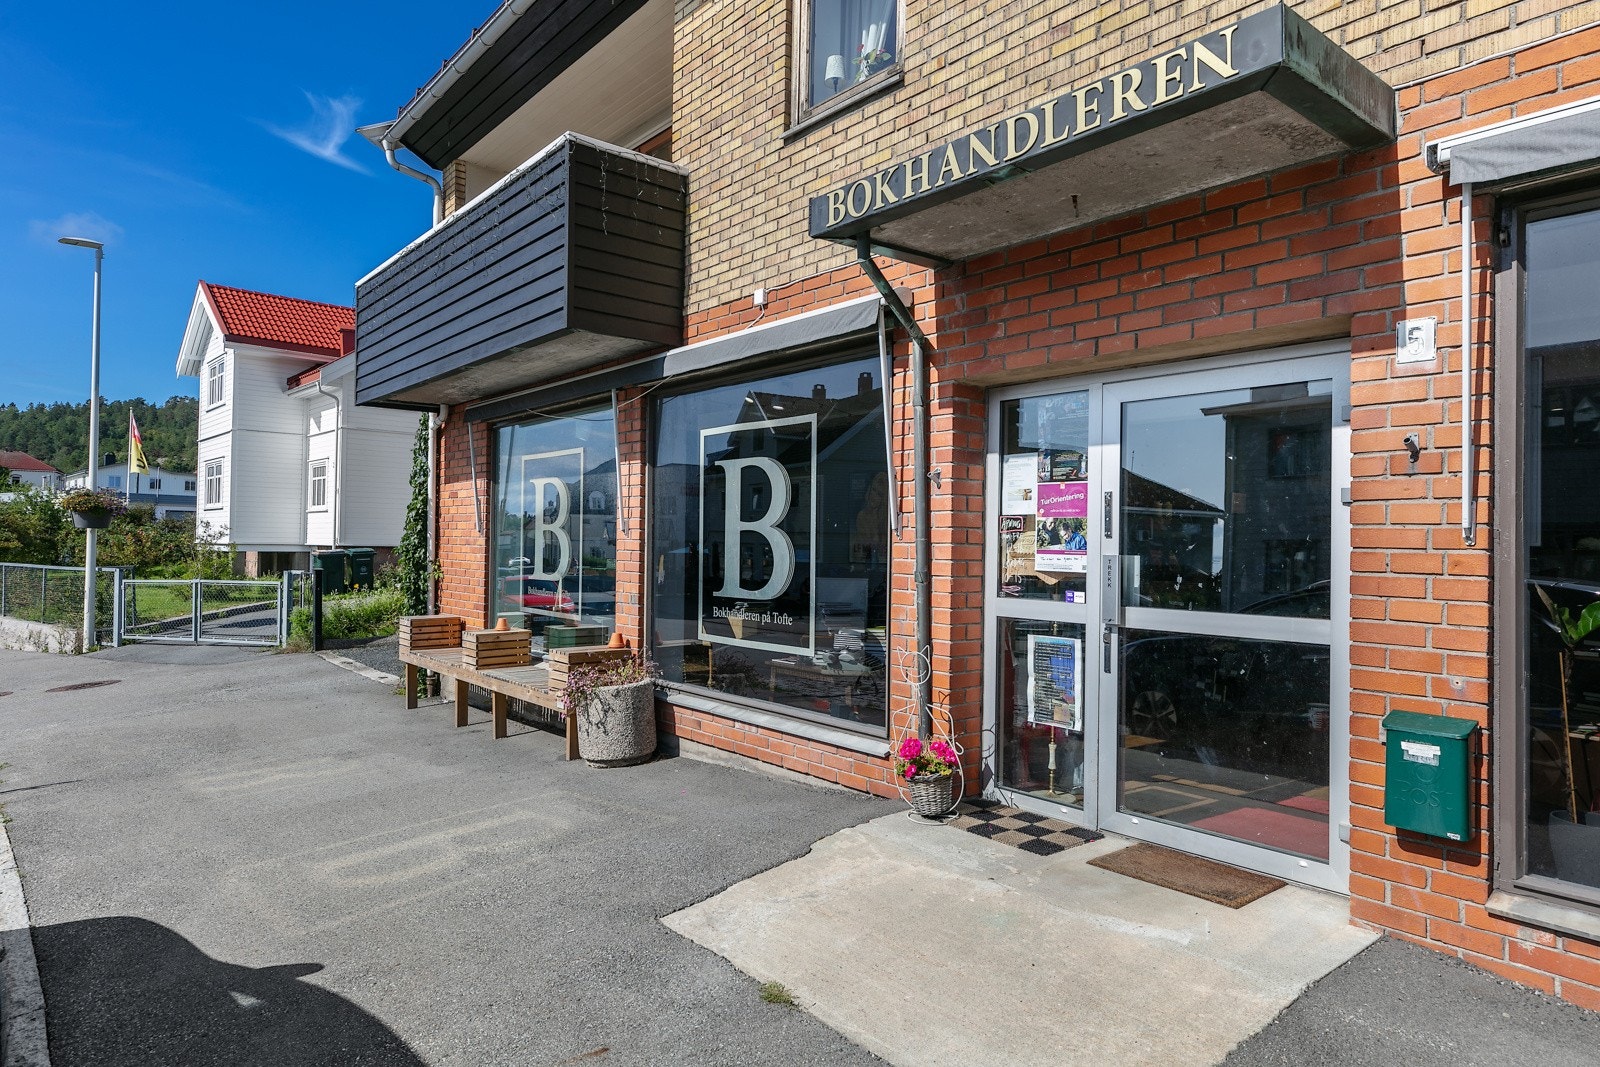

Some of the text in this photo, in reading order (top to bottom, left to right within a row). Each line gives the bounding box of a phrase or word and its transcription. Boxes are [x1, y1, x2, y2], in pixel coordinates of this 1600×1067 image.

[825, 24, 1239, 227] BOKHANDLEREN
[1408, 326, 1424, 355] 5
[529, 477, 571, 581] B
[713, 456, 796, 600] B
[1041, 492, 1085, 506] TurOrientering
[712, 606, 793, 626] Bokhandleren på Tofte
